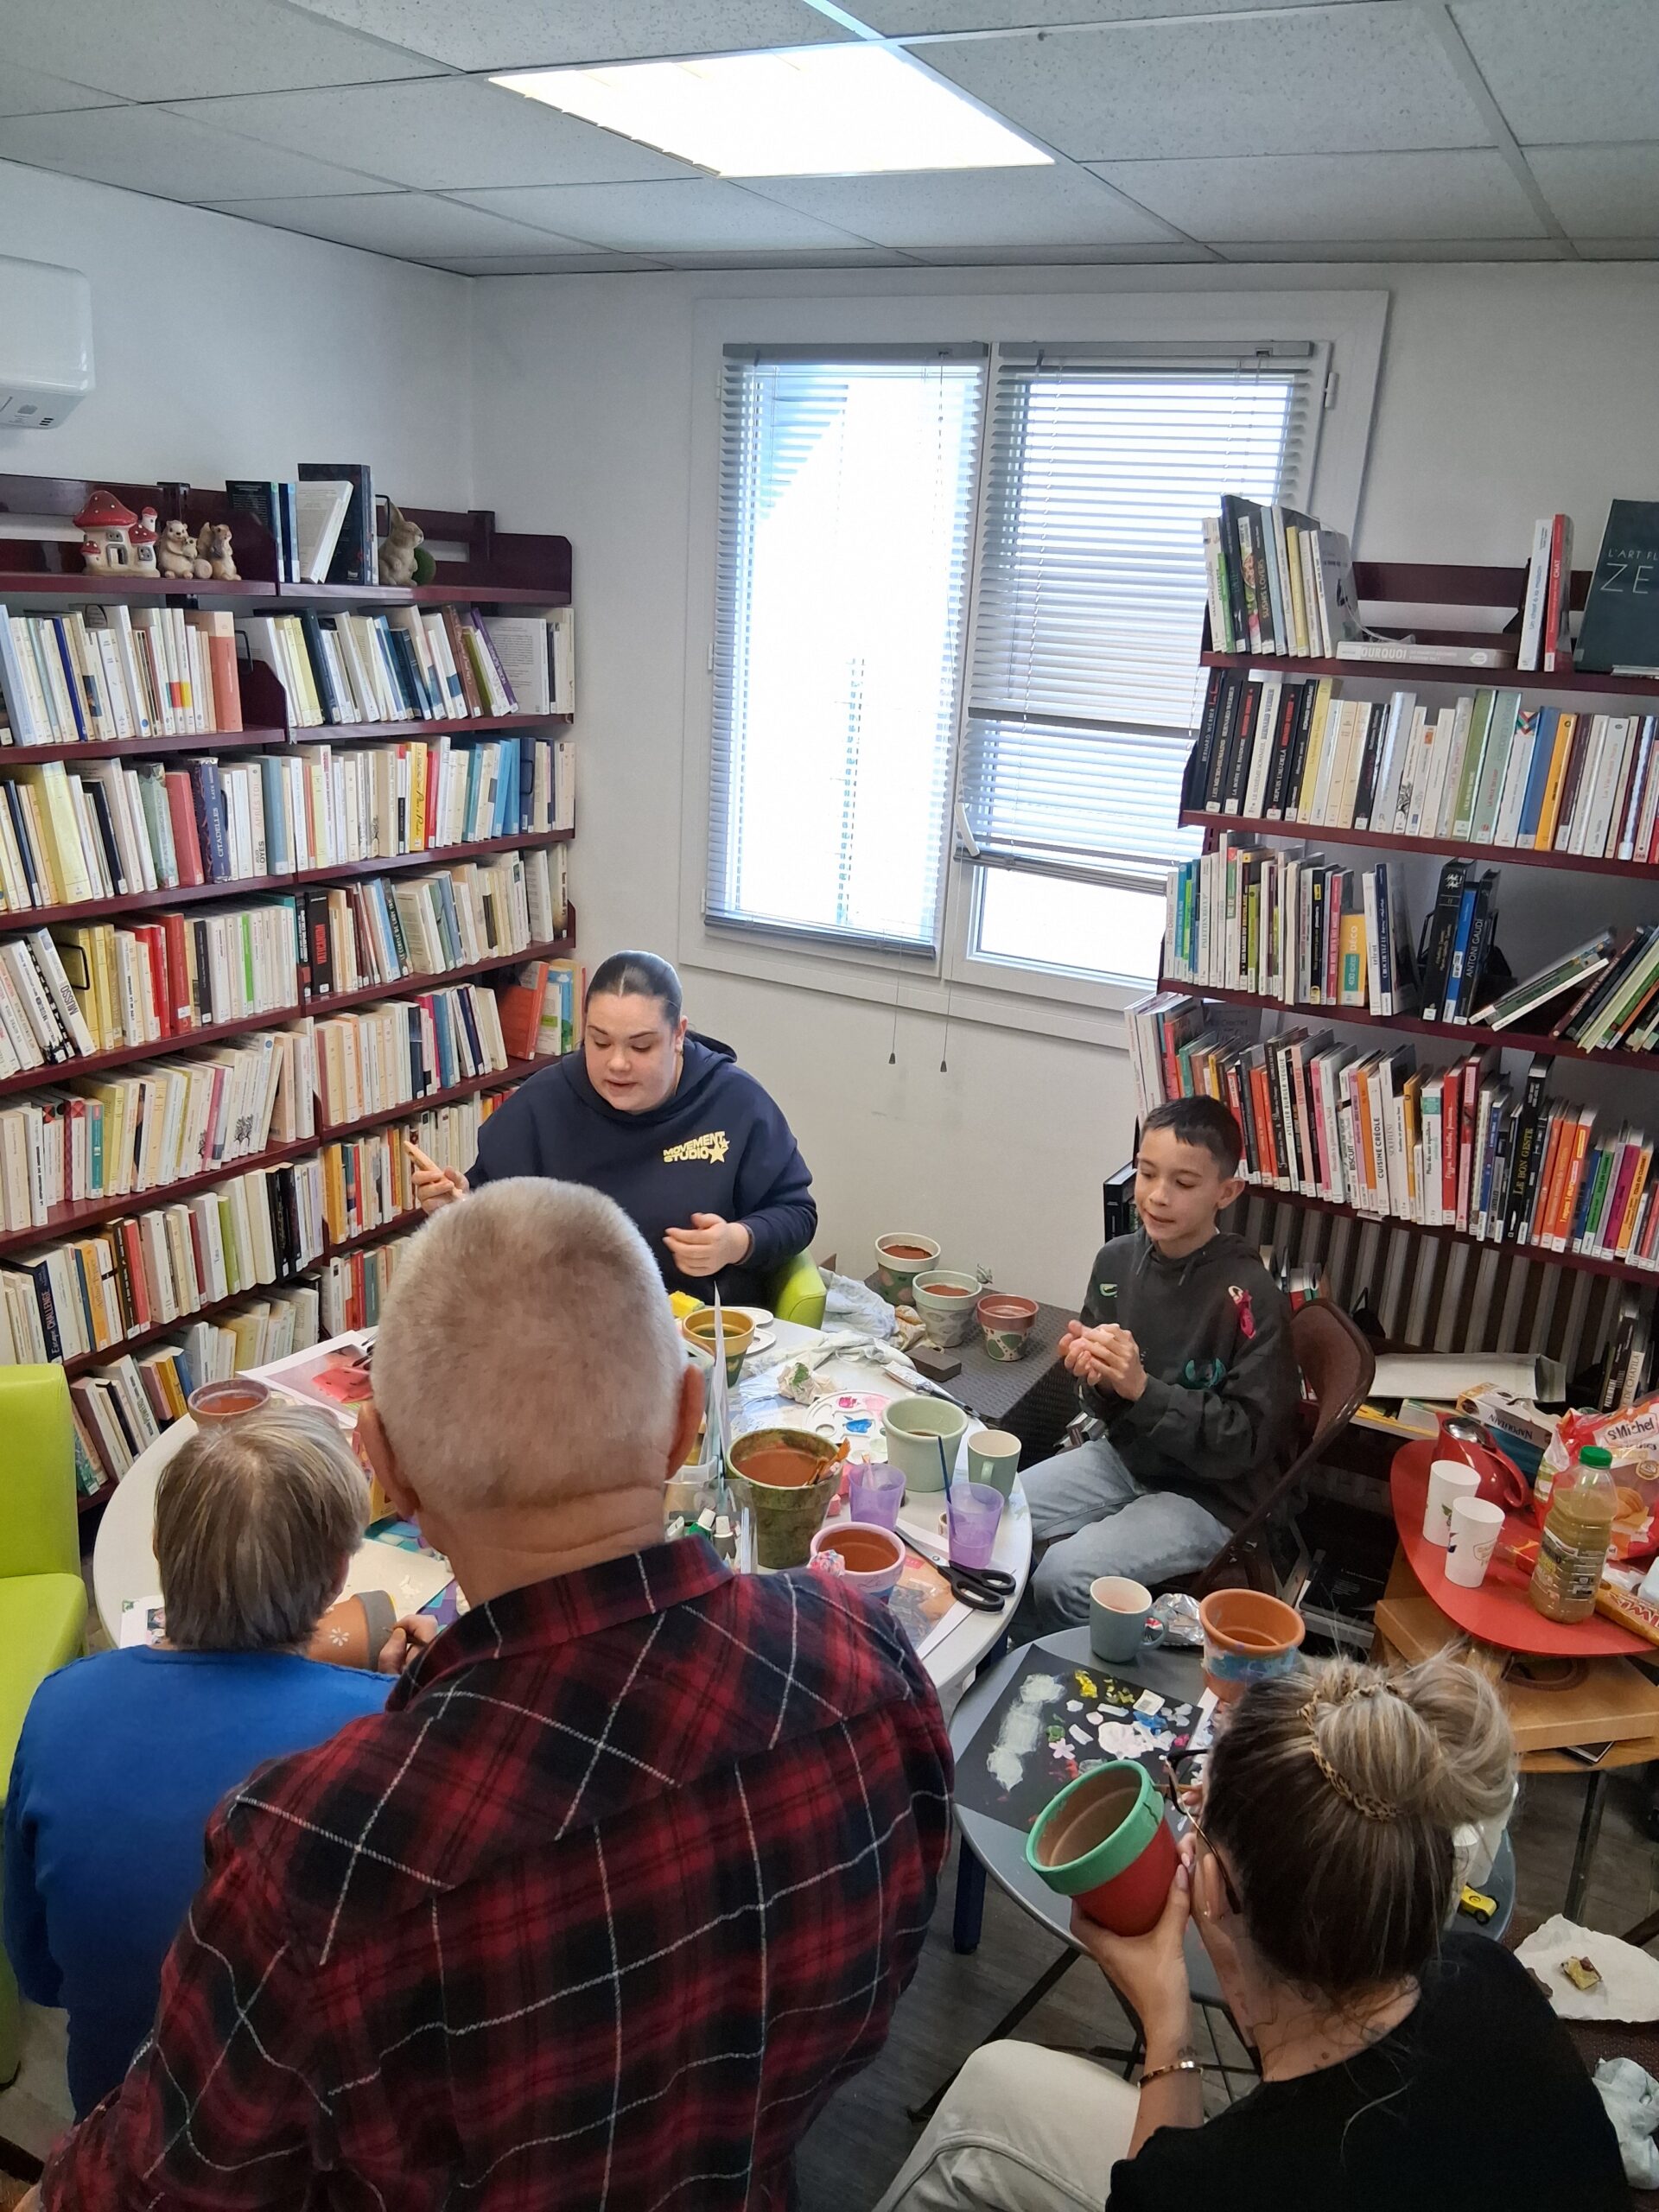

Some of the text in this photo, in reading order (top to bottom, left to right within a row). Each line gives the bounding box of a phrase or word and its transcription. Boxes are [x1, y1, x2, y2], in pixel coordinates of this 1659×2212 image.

[1608, 548, 1642, 559] L'ART
[1361, 646, 1407, 660] OURQUOI
[1270, 779, 1282, 802] DEPUIS
[252, 798, 263, 828] APRÈS
[212, 806, 225, 857] CITADELLES
[257, 840, 266, 863] OYES
[391, 924, 399, 933] DE
[1348, 925, 1357, 951] DÉCO
[315, 923, 327, 964] VATICANUM
[1465, 945, 1478, 978] ANTONI
[1347, 972, 1356, 986] 400
[59, 983, 79, 1016] MUSSO
[1278, 1058, 1287, 1082] VEGGIE
[1284, 1110, 1293, 1136] ATELIER
[663, 1130, 726, 1156] MOVEMENT
[664, 1146, 709, 1163] STUDIO
[1371, 1116, 1384, 1179] CUISINE CRÉOLE
[1346, 1144, 1356, 1171] BISCUIT
[1512, 1127, 1533, 1195] LE BON GESTE
[1565, 1180, 1575, 1198] euro
[1560, 1199, 1572, 1219] repas
[40, 1287, 61, 1354] Escape CHALLENGE
[1489, 1413, 1534, 1440] NAPOLITAIN
